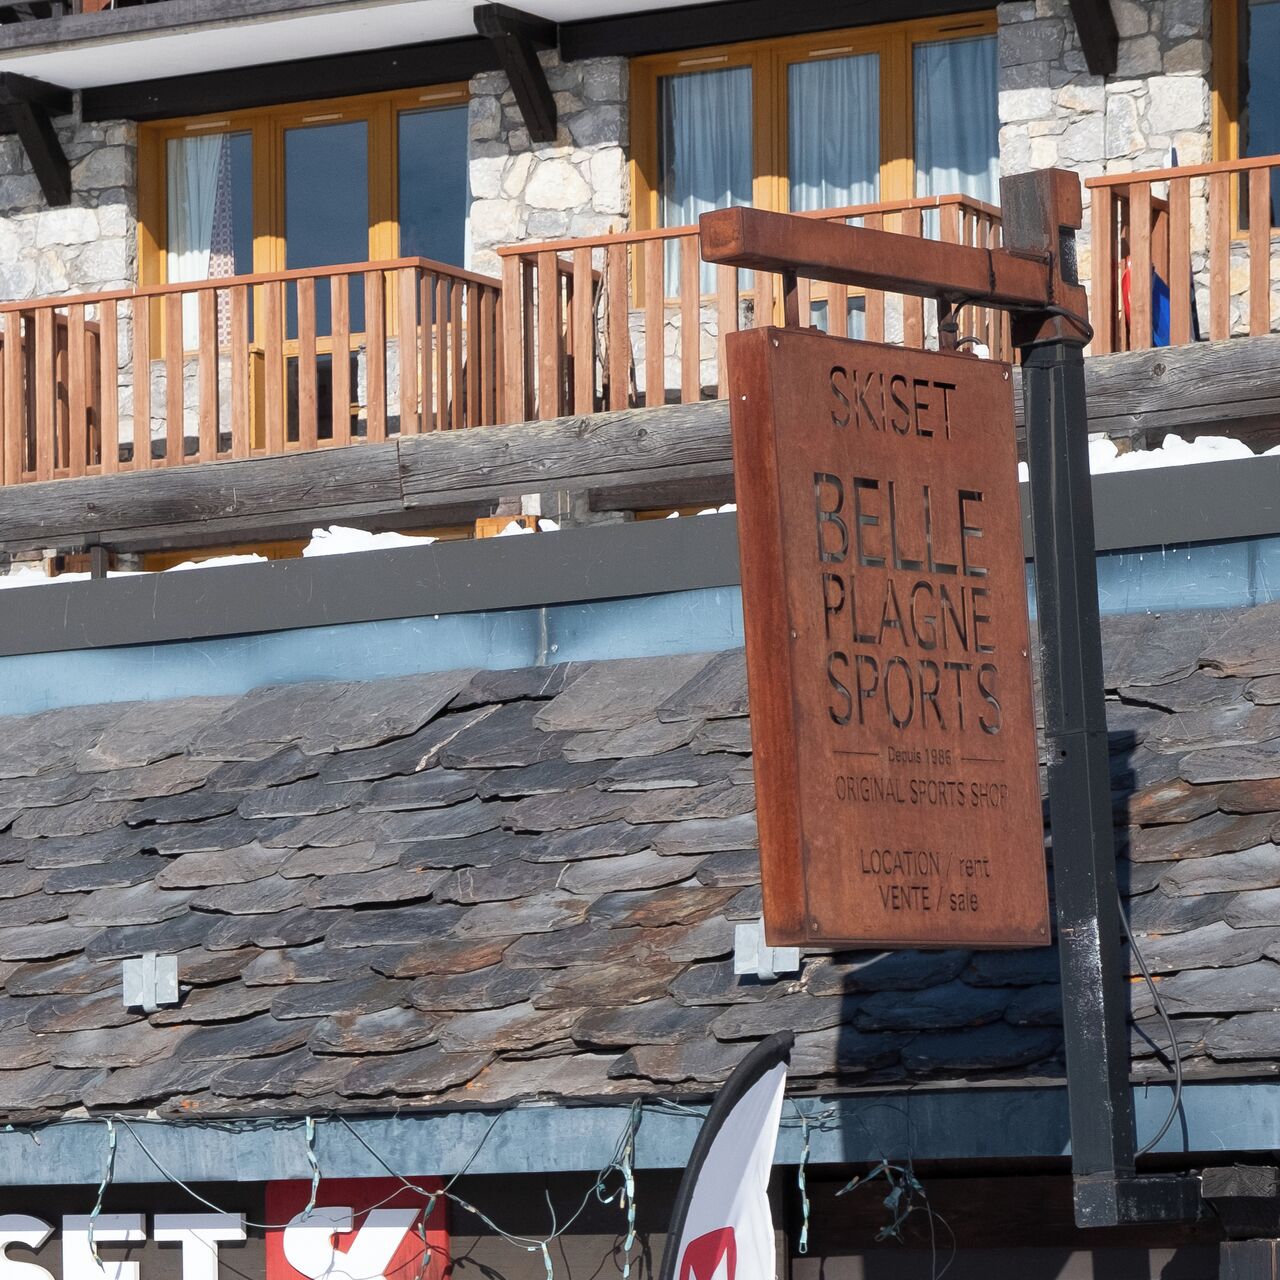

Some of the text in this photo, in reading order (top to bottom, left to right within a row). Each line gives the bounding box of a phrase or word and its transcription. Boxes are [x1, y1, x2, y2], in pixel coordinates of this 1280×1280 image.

[829, 365, 957, 440] SKISET
[813, 471, 990, 577] BELLE
[822, 572, 995, 654] PLAGNE
[827, 651, 1003, 735] SPORTS
[888, 746, 951, 765] Depuis 1986
[835, 775, 1008, 808] ORIGINAL SPORTS SHOP
[860, 849, 940, 877] LOCATION
[959, 857, 990, 878] rent
[879, 885, 931, 911] VENTE
[949, 887, 979, 912] sale
